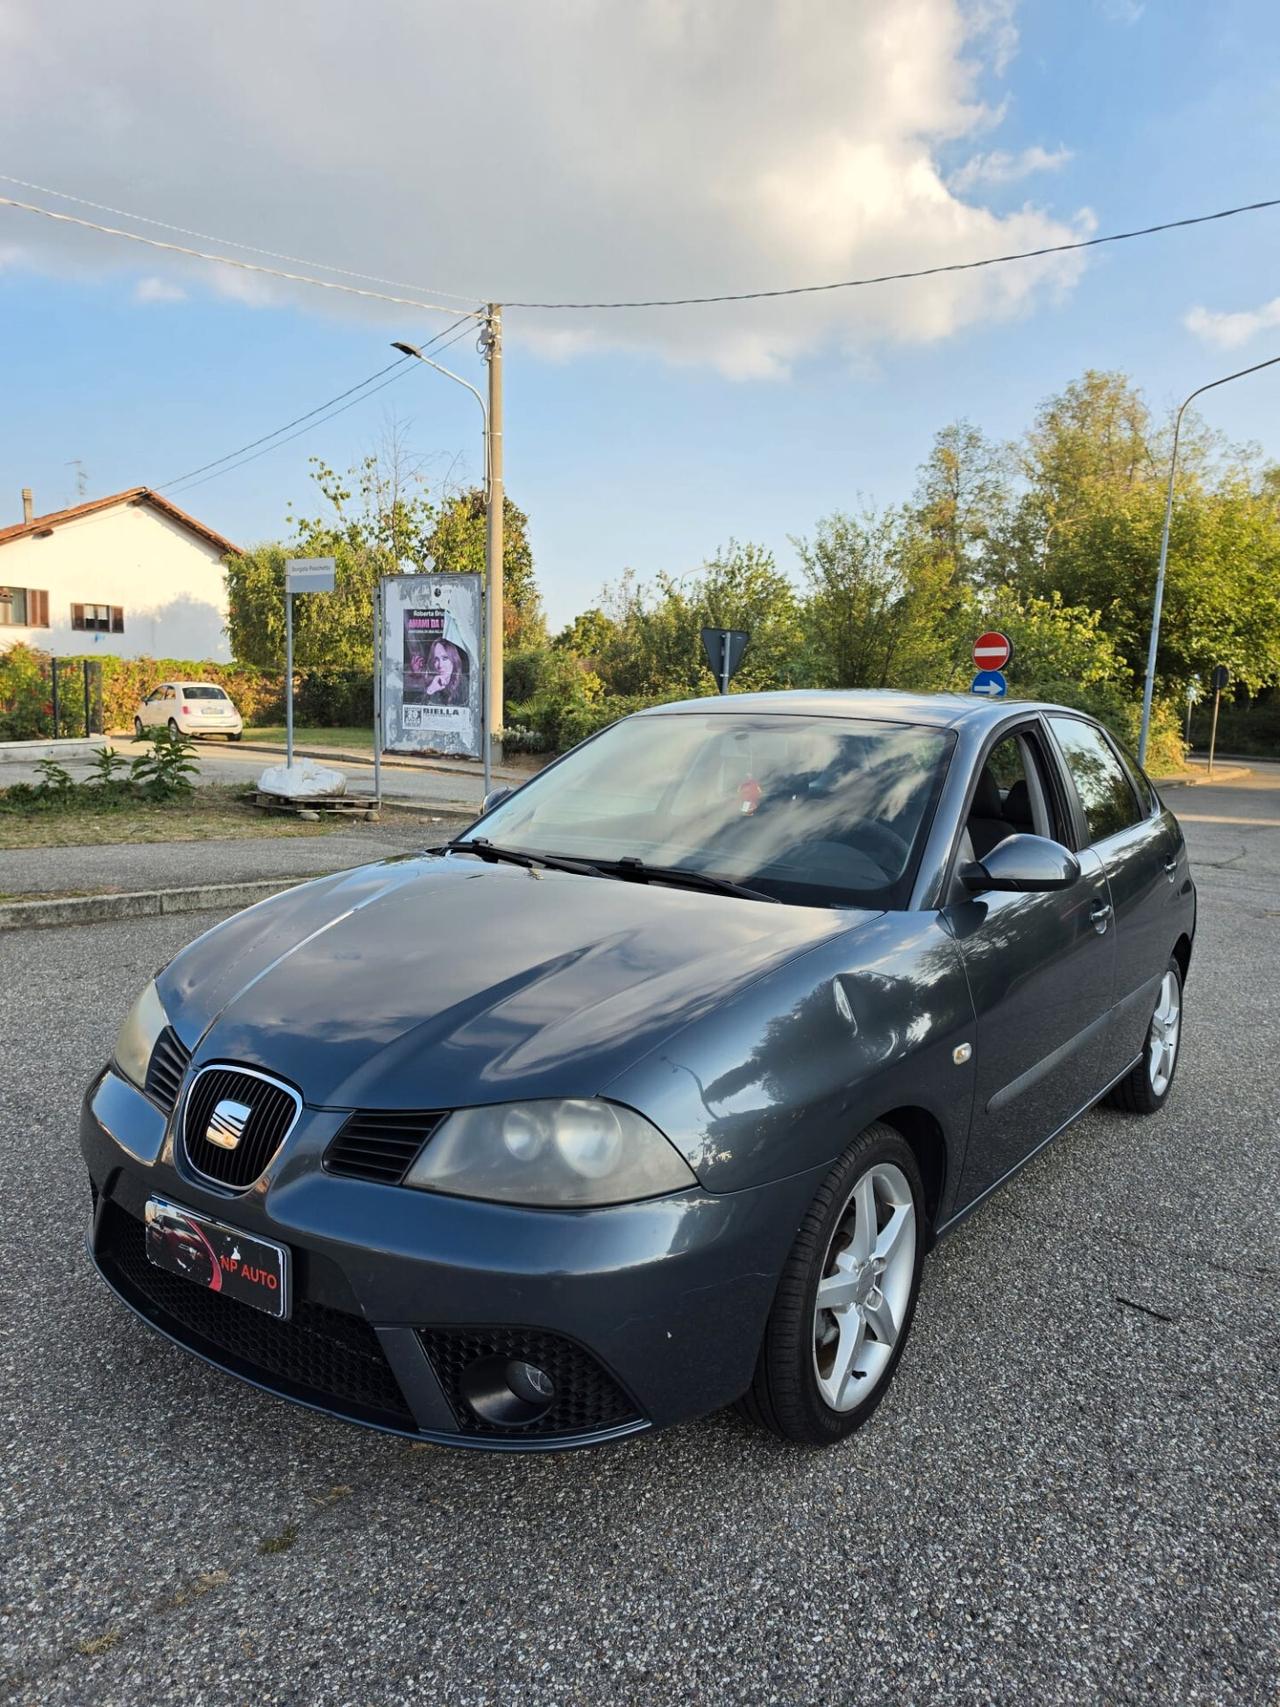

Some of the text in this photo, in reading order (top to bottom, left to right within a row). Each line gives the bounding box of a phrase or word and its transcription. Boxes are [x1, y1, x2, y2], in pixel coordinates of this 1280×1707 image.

[423, 708, 460, 716] BIELLA
[220, 1257, 277, 1290] NP AUTO
